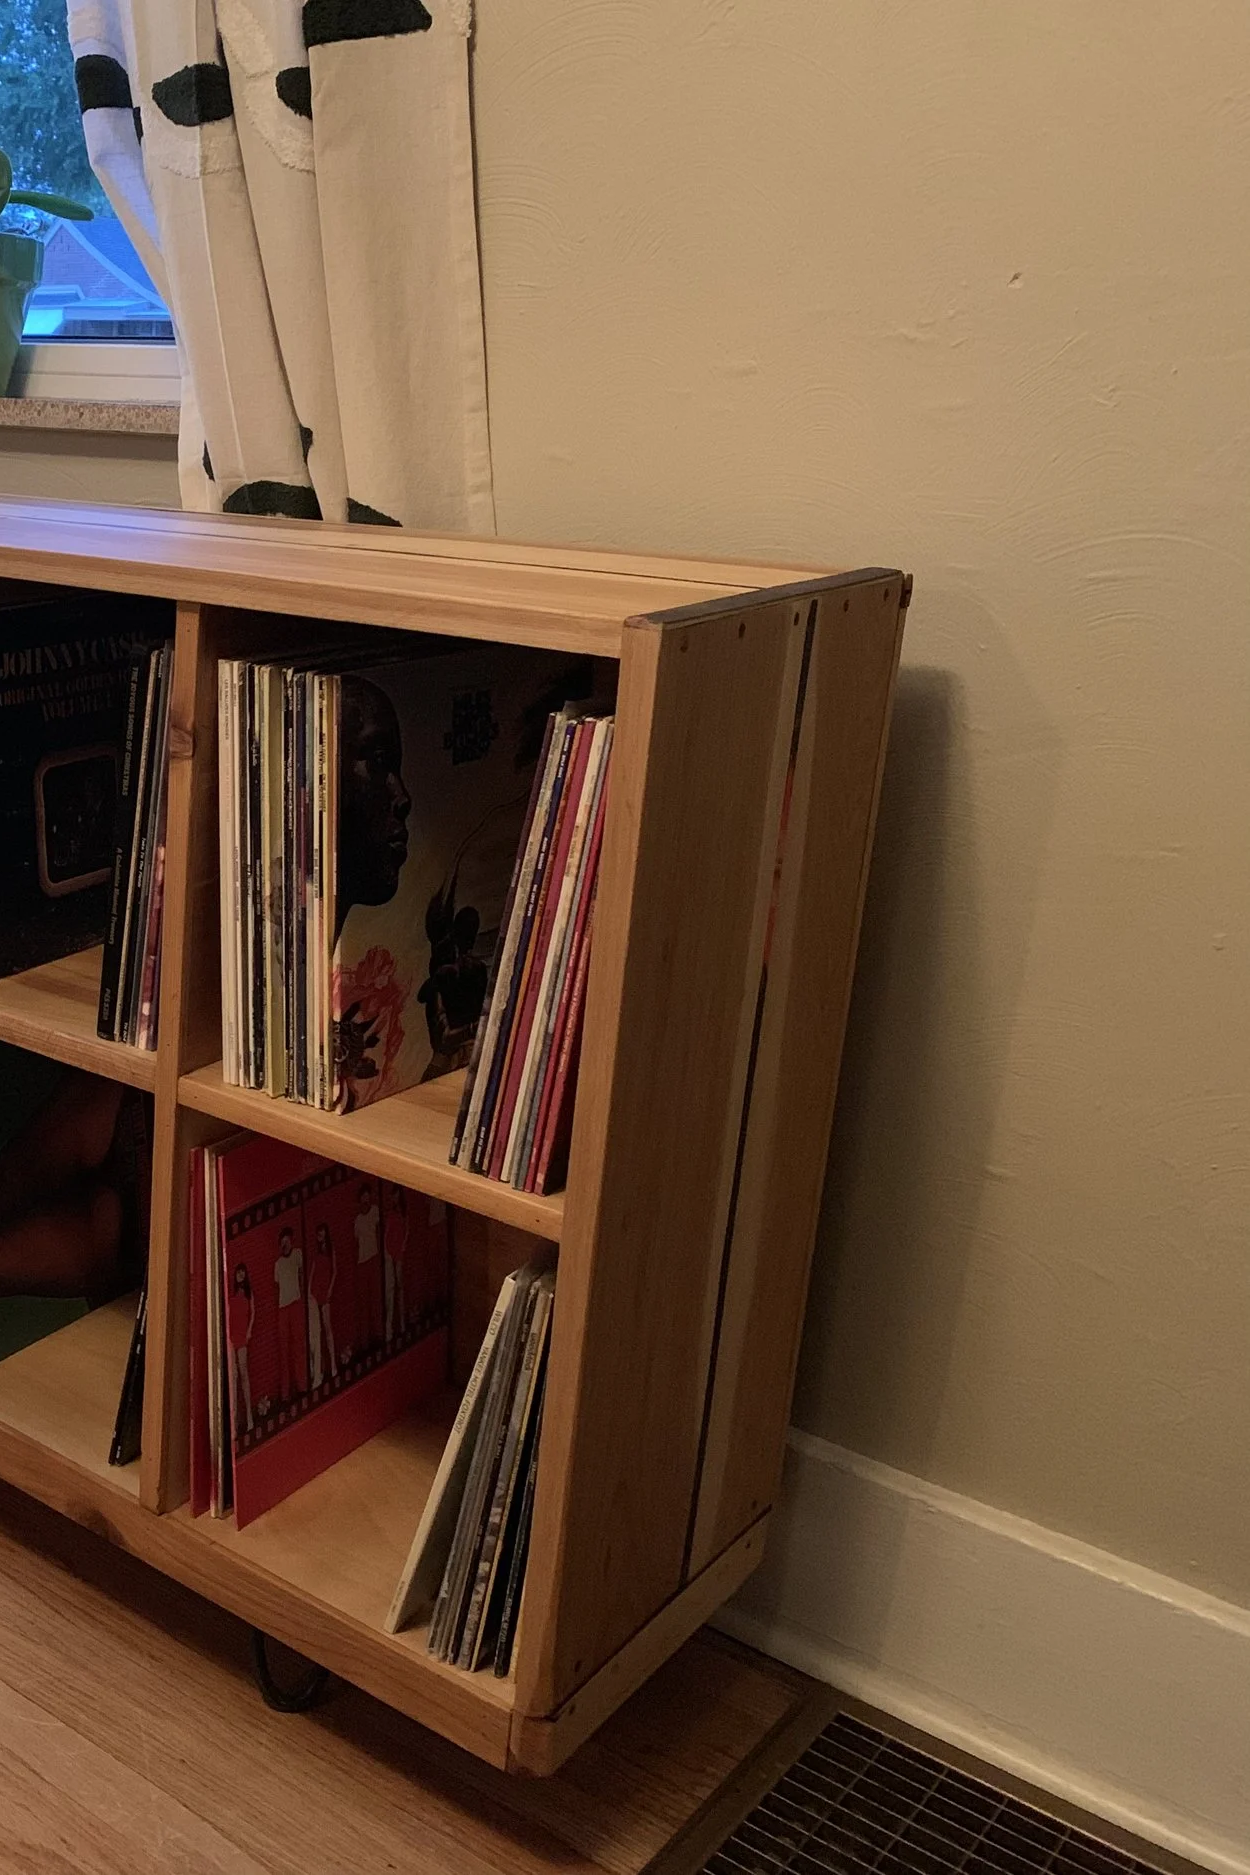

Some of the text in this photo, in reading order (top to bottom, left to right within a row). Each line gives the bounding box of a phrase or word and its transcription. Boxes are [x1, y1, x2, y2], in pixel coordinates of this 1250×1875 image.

[125, 714, 135, 740] SONGS
[487, 1311, 502, 1336] WILCO
[453, 1346, 490, 1434] YANKEE HOTEL FOXTROT
